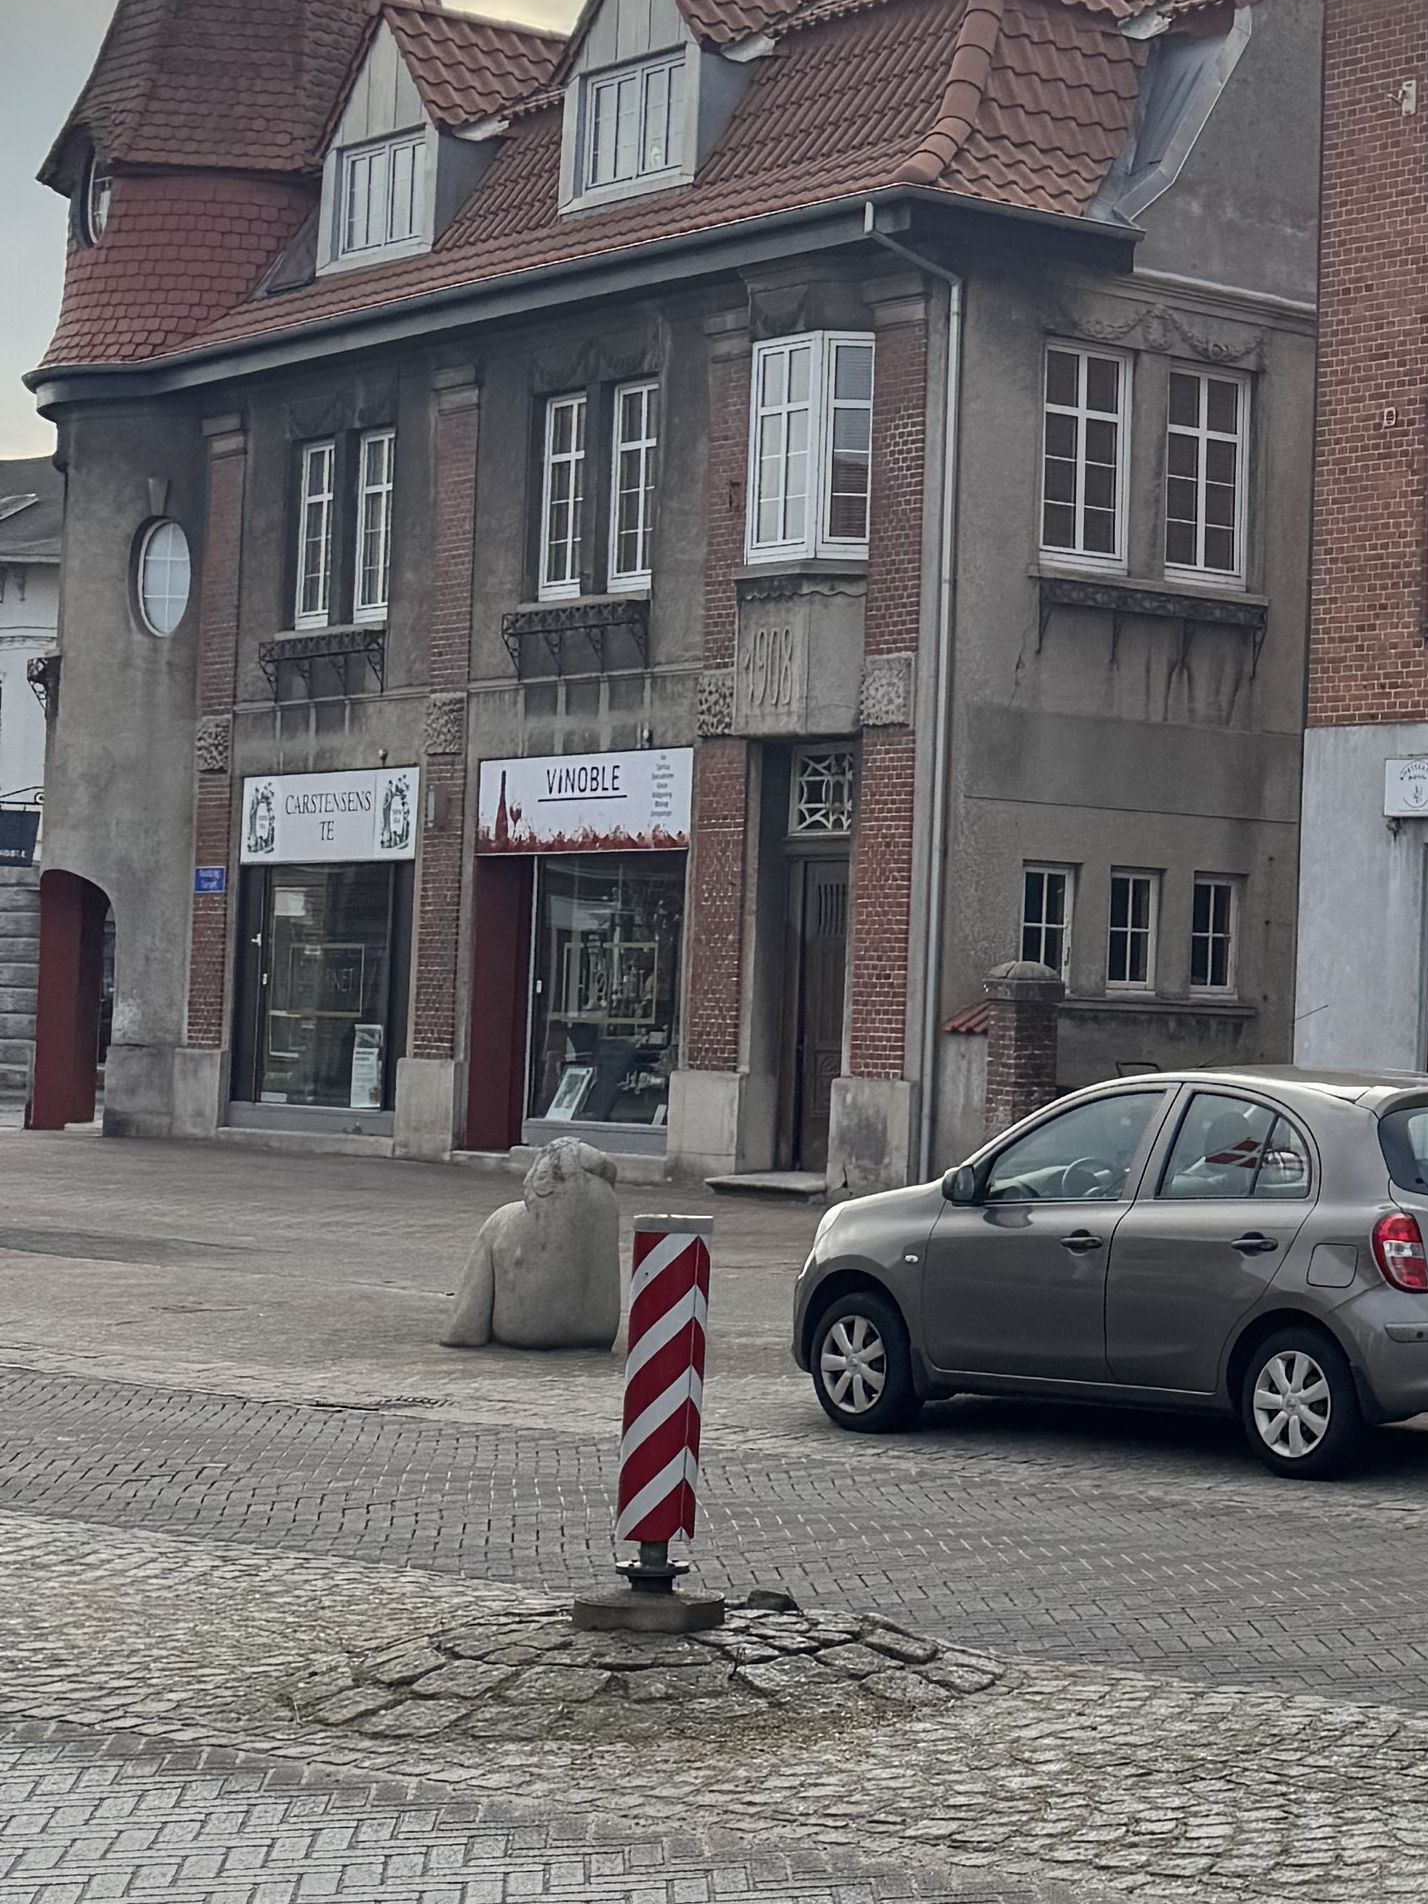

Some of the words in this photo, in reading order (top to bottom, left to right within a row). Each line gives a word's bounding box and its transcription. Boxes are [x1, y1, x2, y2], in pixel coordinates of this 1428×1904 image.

[546, 765, 621, 795] VINOBLE
[285, 790, 372, 815] CARSTENSENS
[319, 820, 335, 841] TE
